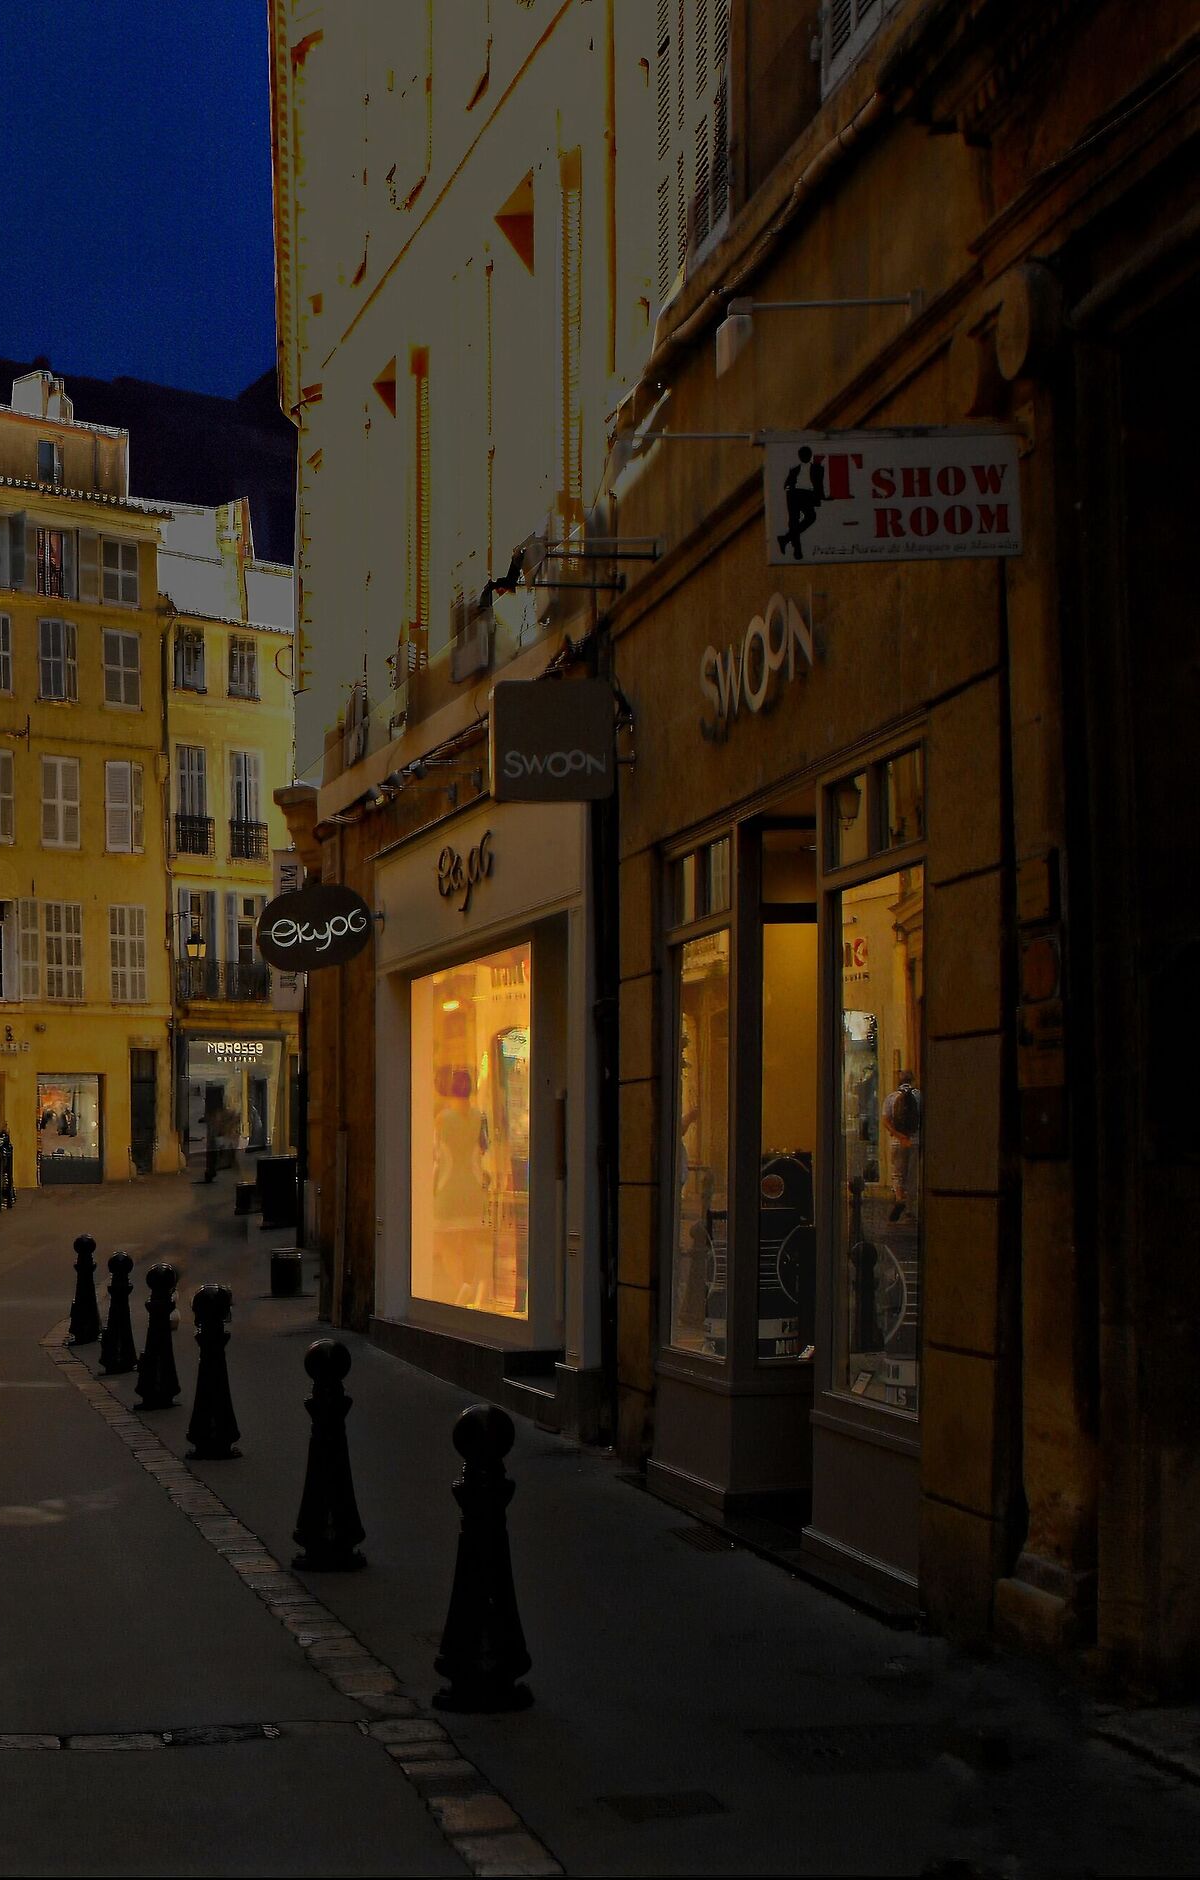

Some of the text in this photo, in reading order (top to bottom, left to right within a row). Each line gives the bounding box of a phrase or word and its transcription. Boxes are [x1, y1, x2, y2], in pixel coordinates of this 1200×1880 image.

[870, 464, 1008, 499] SHOW
[873, 503, 1010, 538] ROOM
[700, 583, 814, 721] SWOON
[503, 749, 606, 778] SWOON
